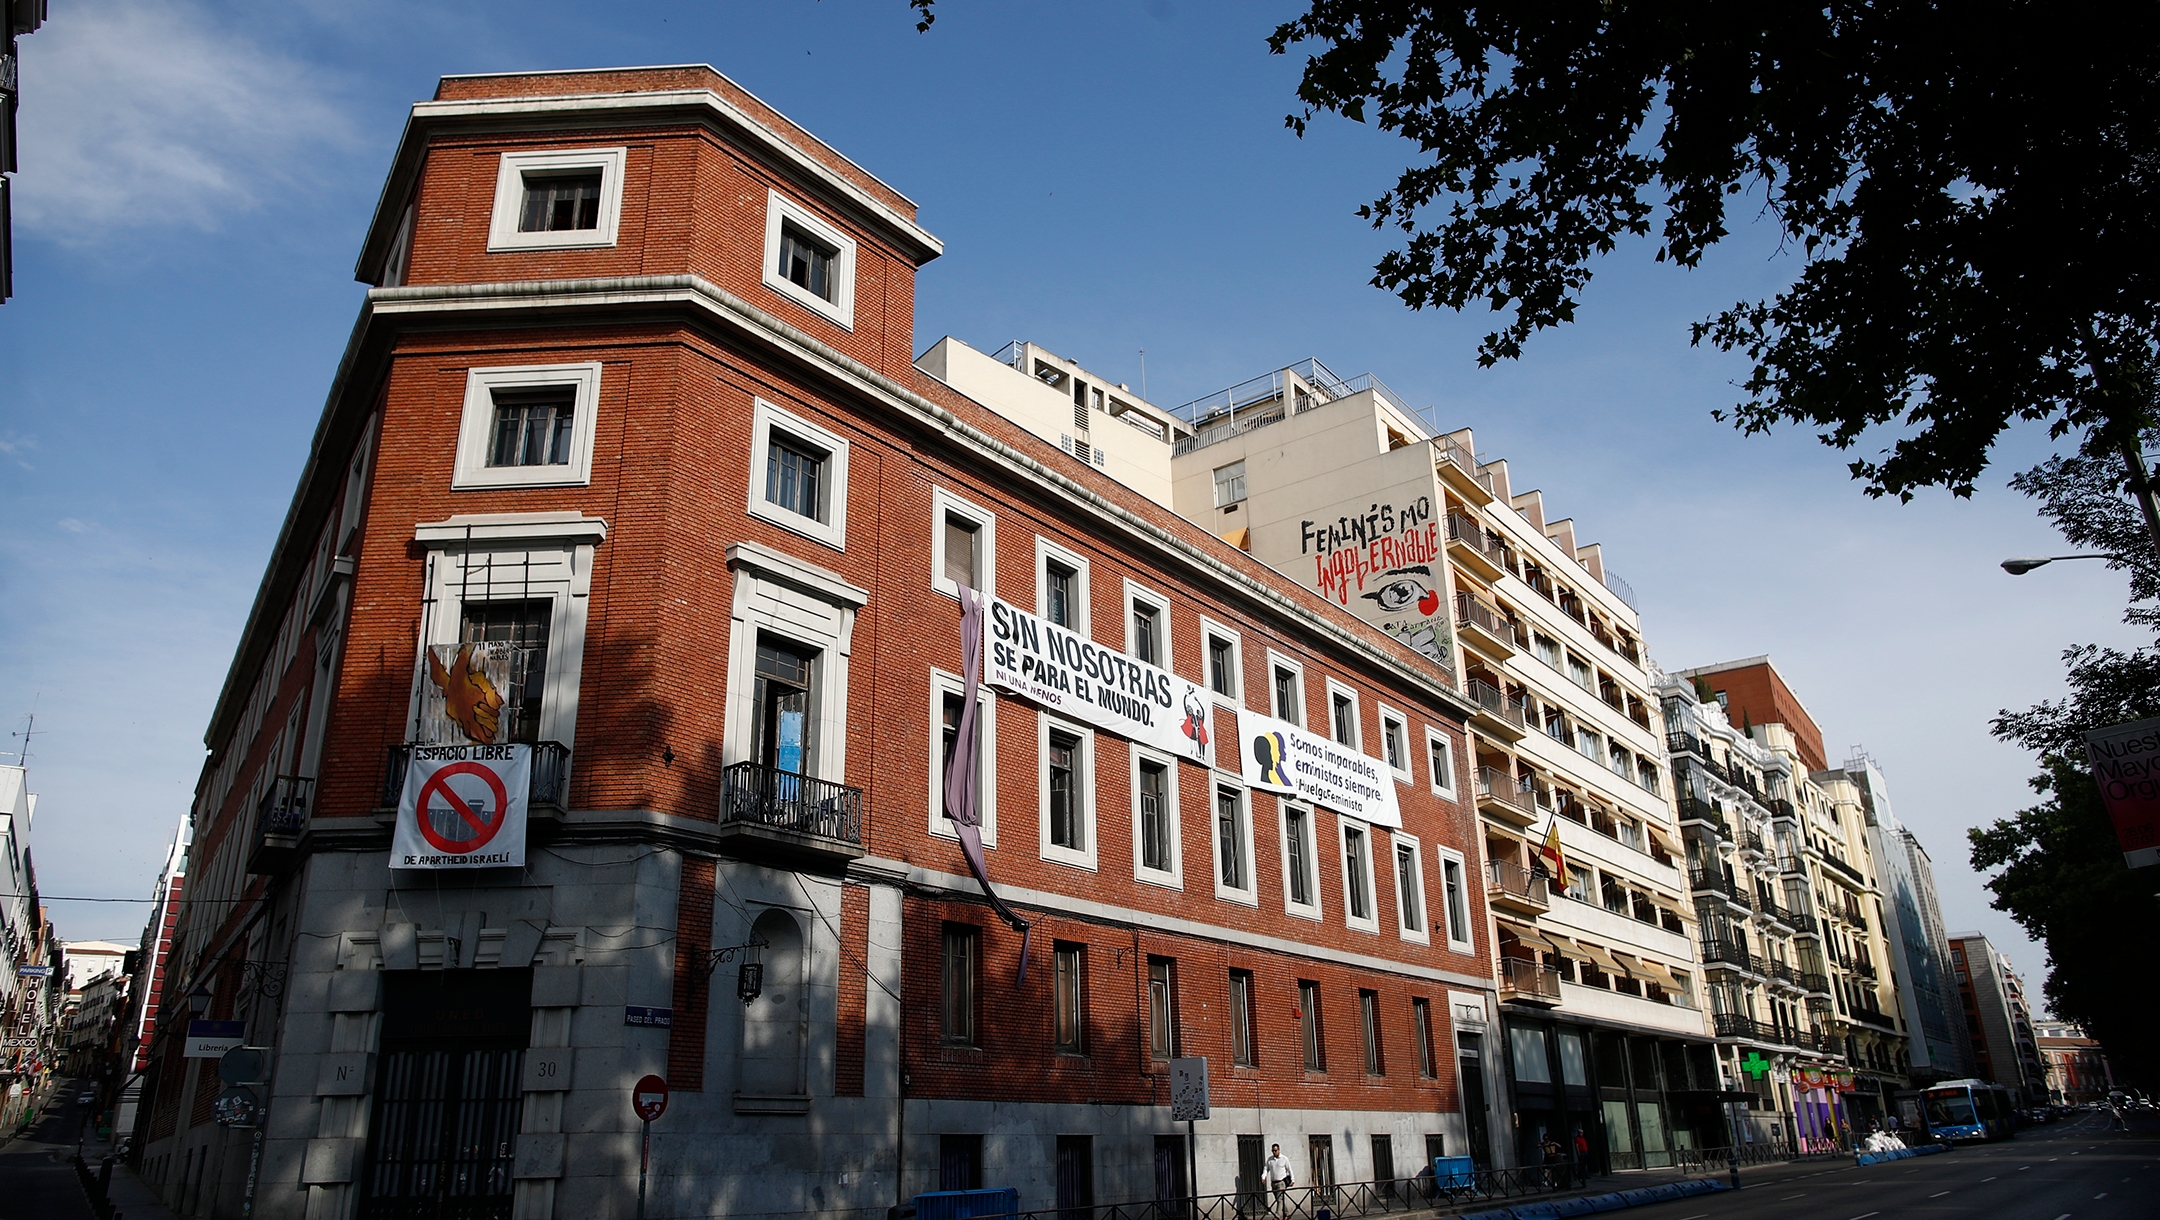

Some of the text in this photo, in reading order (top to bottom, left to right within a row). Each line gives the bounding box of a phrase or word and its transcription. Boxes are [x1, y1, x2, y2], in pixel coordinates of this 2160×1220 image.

[992, 602, 1173, 709] SIN NOSOTRAS
[994, 641, 1155, 728] SE PARA EL MUNDO.
[996, 669, 1007, 681] NI
[1009, 675, 1028, 691] UNA
[415, 746, 467, 760] ESPACIO
[1290, 732, 1379, 784] Somos imparables,
[1294, 755, 1343, 788] eministas
[404, 855, 416, 865] DE
[20, 967, 46, 975] PARKING
[19, 978, 40, 1036] HOTEL
[627, 1014, 671, 1025] PASEO DEL PRADO
[538, 1061, 556, 1078] 30
